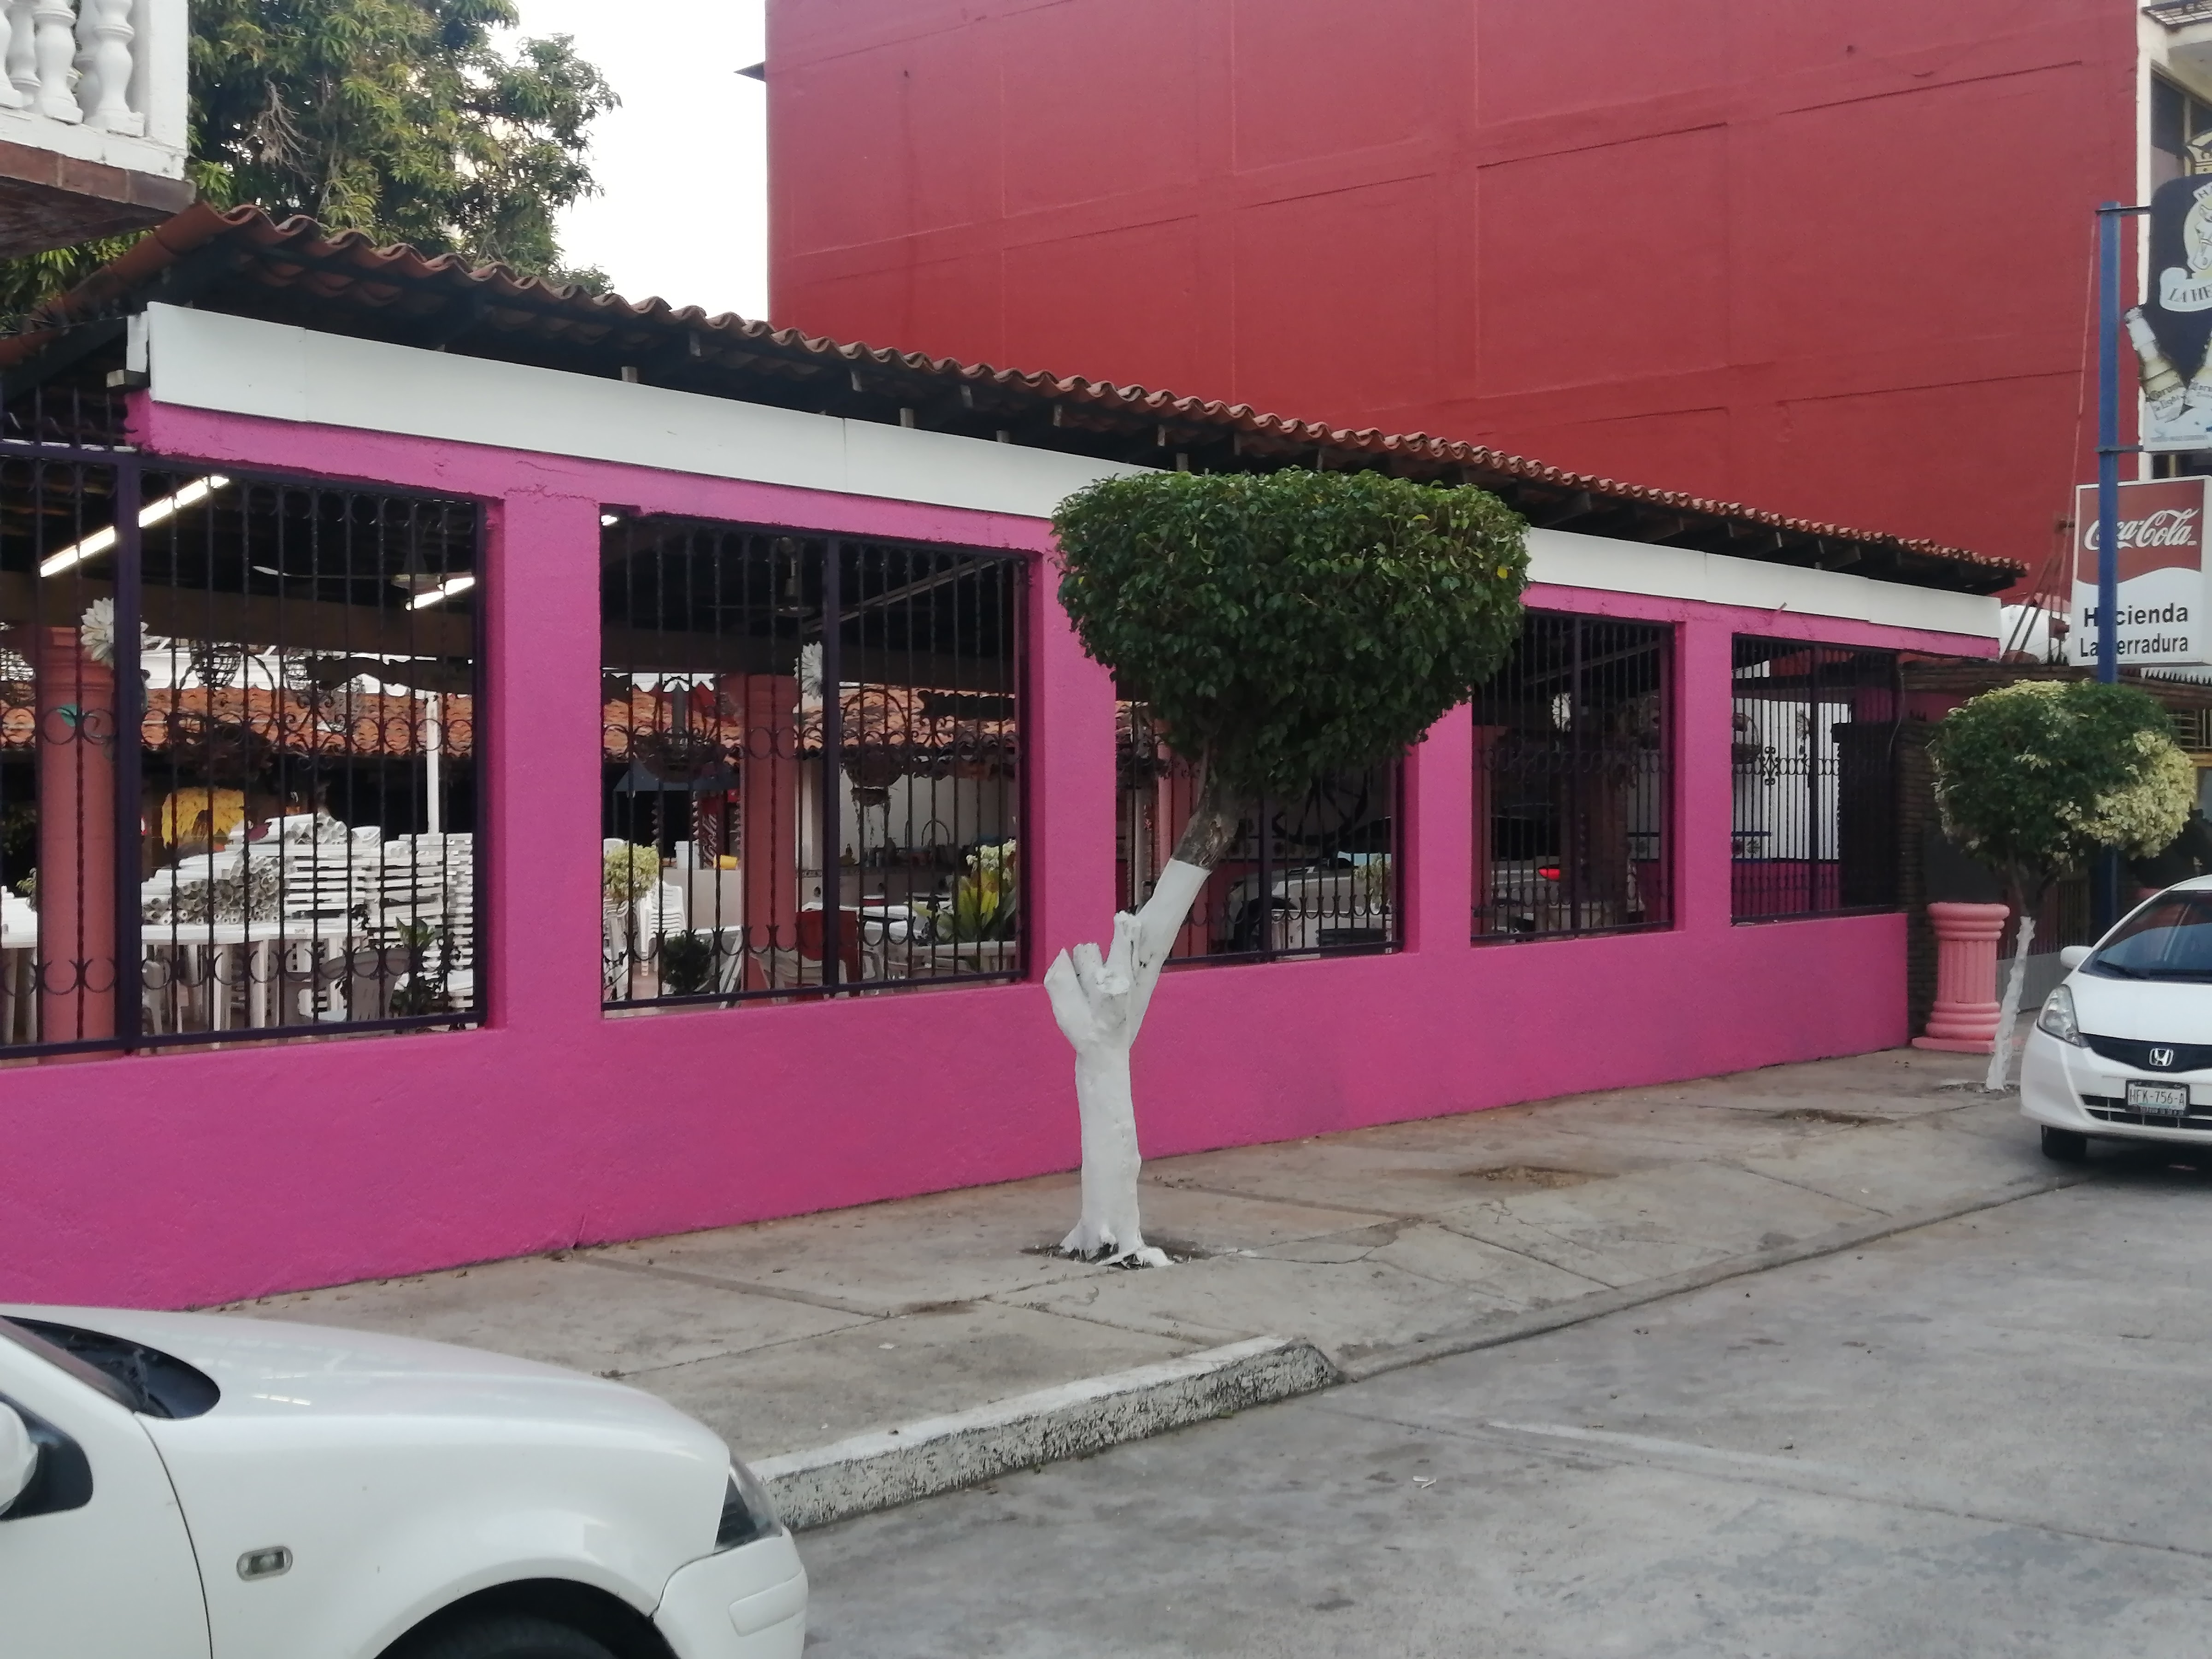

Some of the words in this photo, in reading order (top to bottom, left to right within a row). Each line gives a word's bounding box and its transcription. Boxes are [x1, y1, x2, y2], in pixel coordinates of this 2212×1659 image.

[2167, 287, 2187, 303] LA
[2084, 602, 2188, 628] Hcienda
[2115, 632, 2188, 655] erradura
